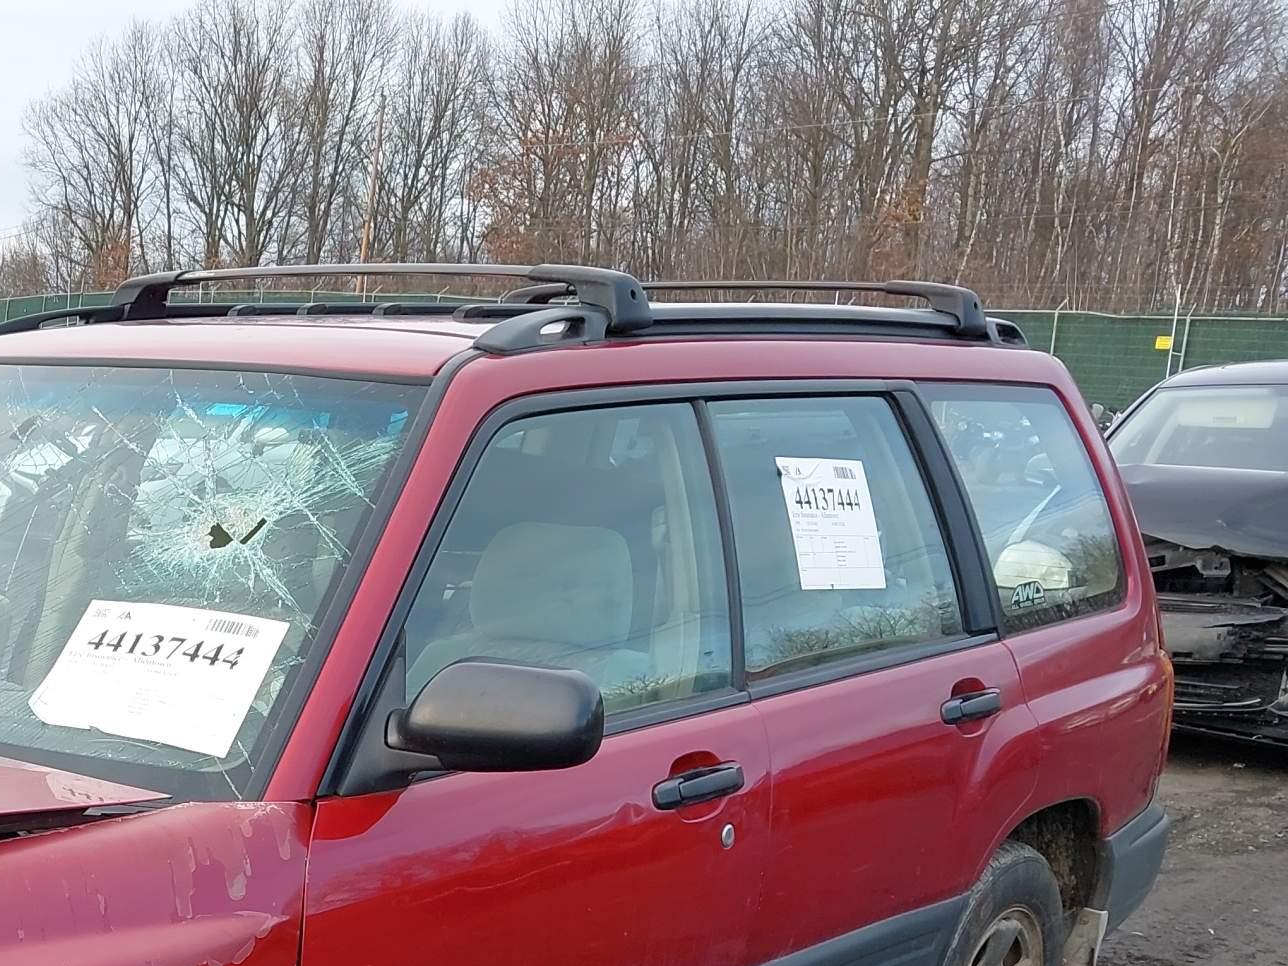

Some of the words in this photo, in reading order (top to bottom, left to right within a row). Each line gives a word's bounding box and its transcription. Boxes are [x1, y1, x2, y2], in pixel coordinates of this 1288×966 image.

[795, 487, 861, 512] 44137444
[1011, 582, 1044, 604] AWD
[87, 629, 246, 671] 44137444
